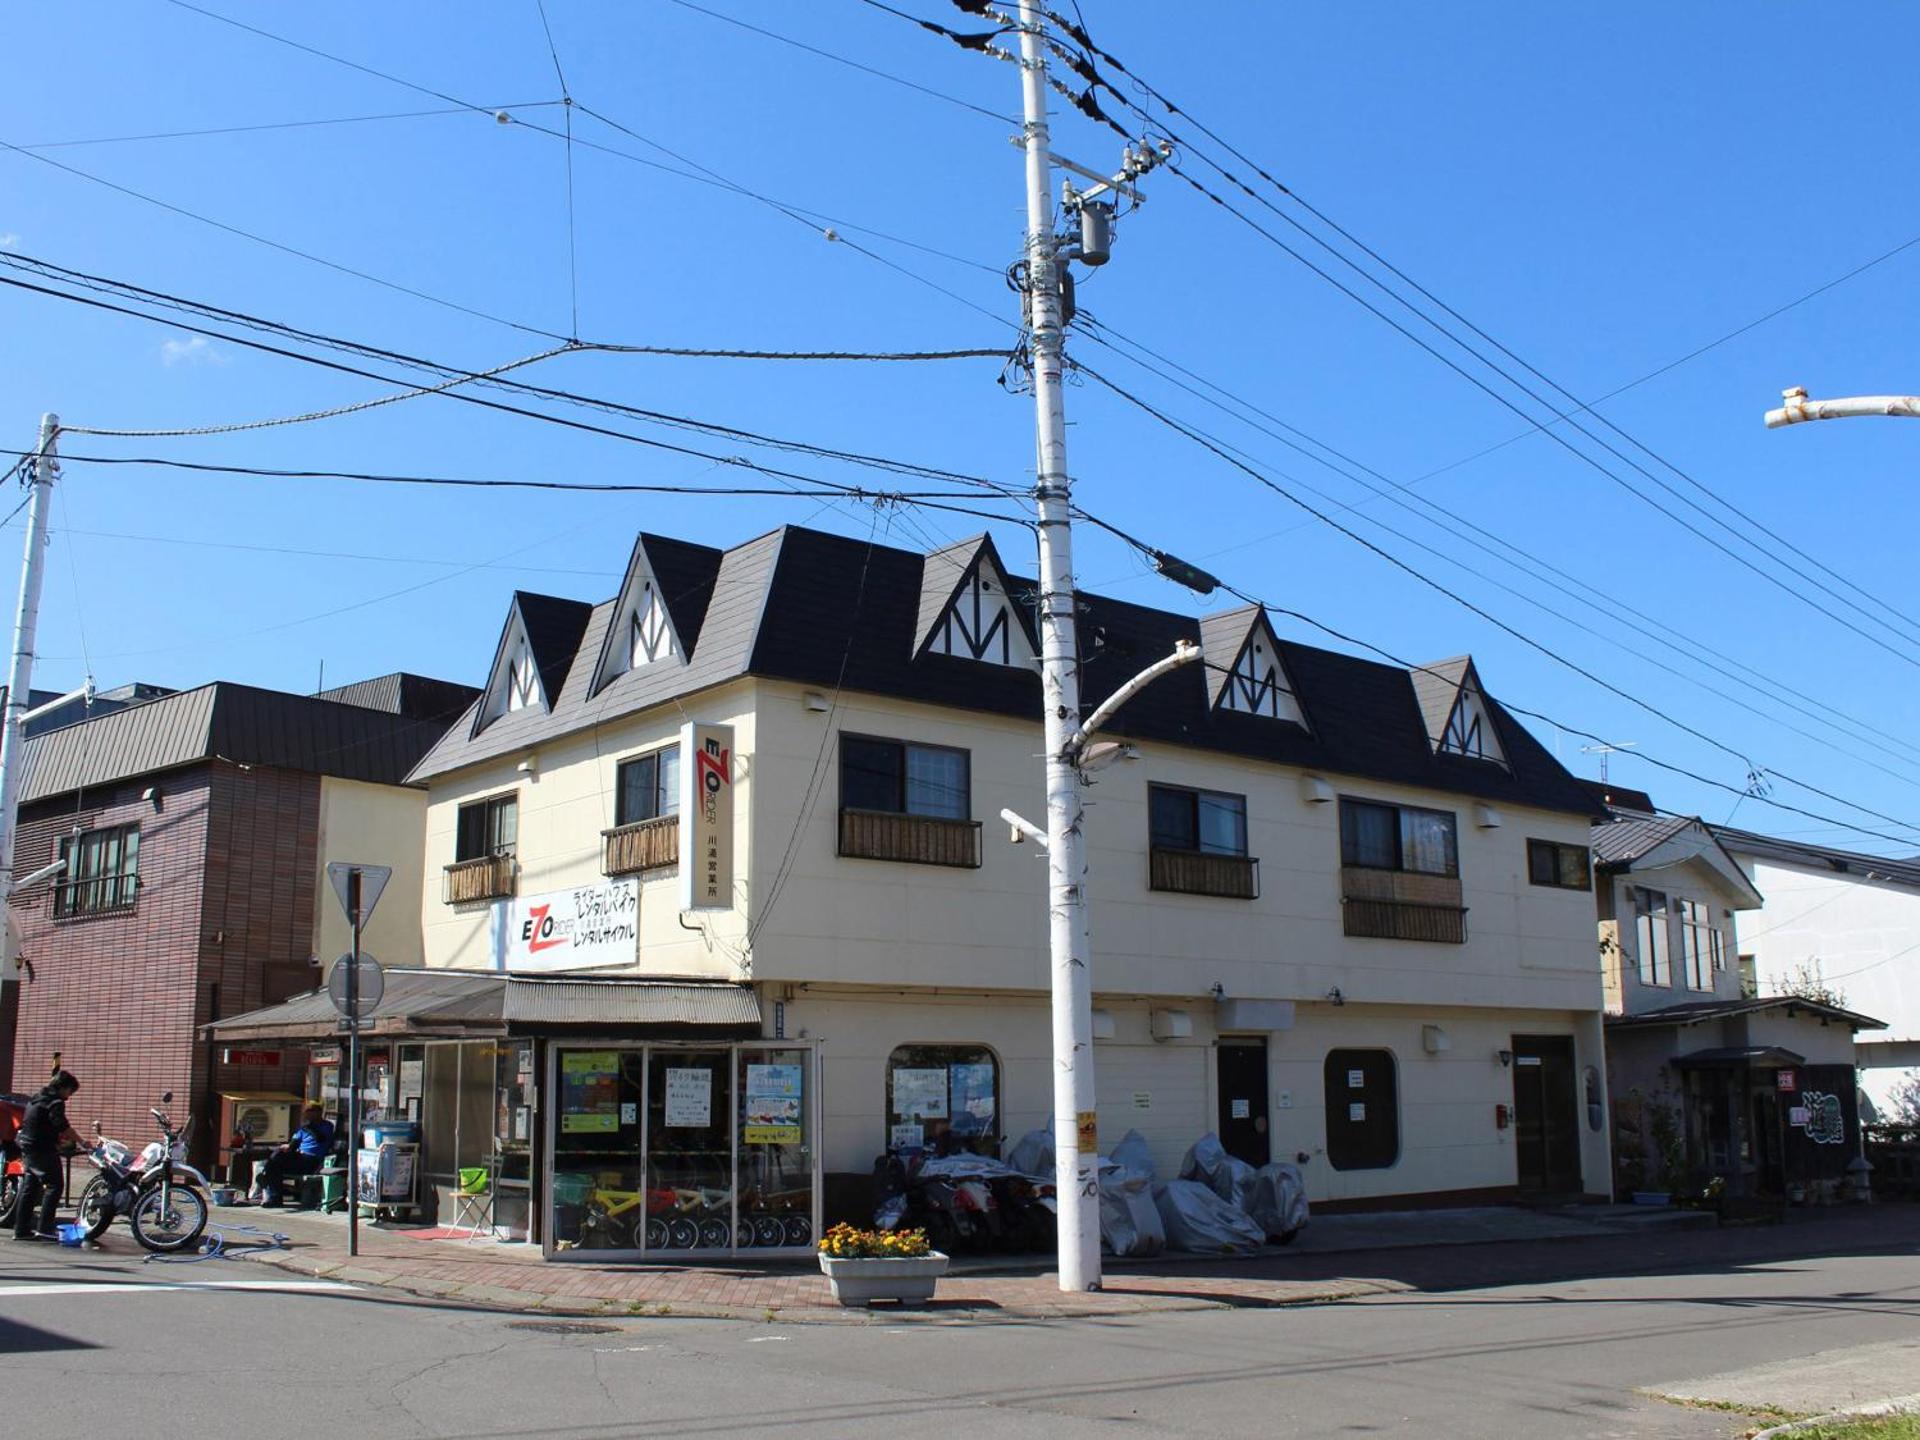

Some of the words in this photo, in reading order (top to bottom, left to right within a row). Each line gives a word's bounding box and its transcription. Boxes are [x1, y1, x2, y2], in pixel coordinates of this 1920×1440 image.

[573, 923, 636, 948] レンタルサイクル
